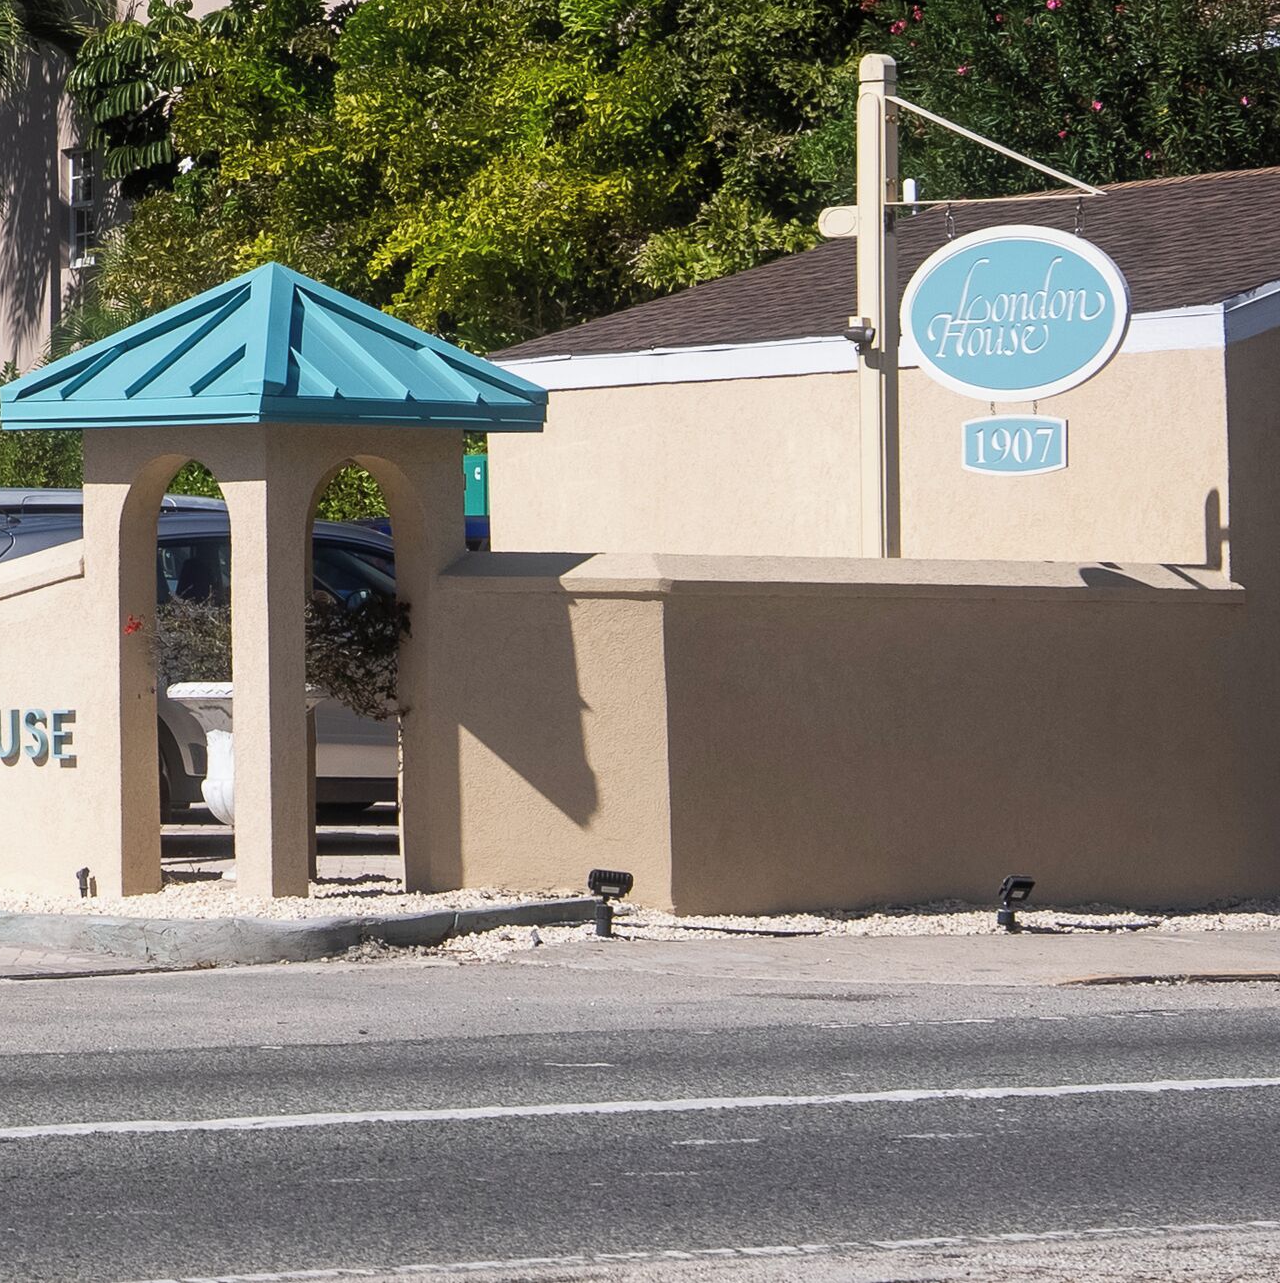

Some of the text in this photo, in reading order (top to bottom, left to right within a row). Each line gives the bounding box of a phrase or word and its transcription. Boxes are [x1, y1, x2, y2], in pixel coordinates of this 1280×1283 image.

[949, 256, 1106, 323] London
[927, 295, 1050, 358] House
[974, 426, 1054, 464] 1907
